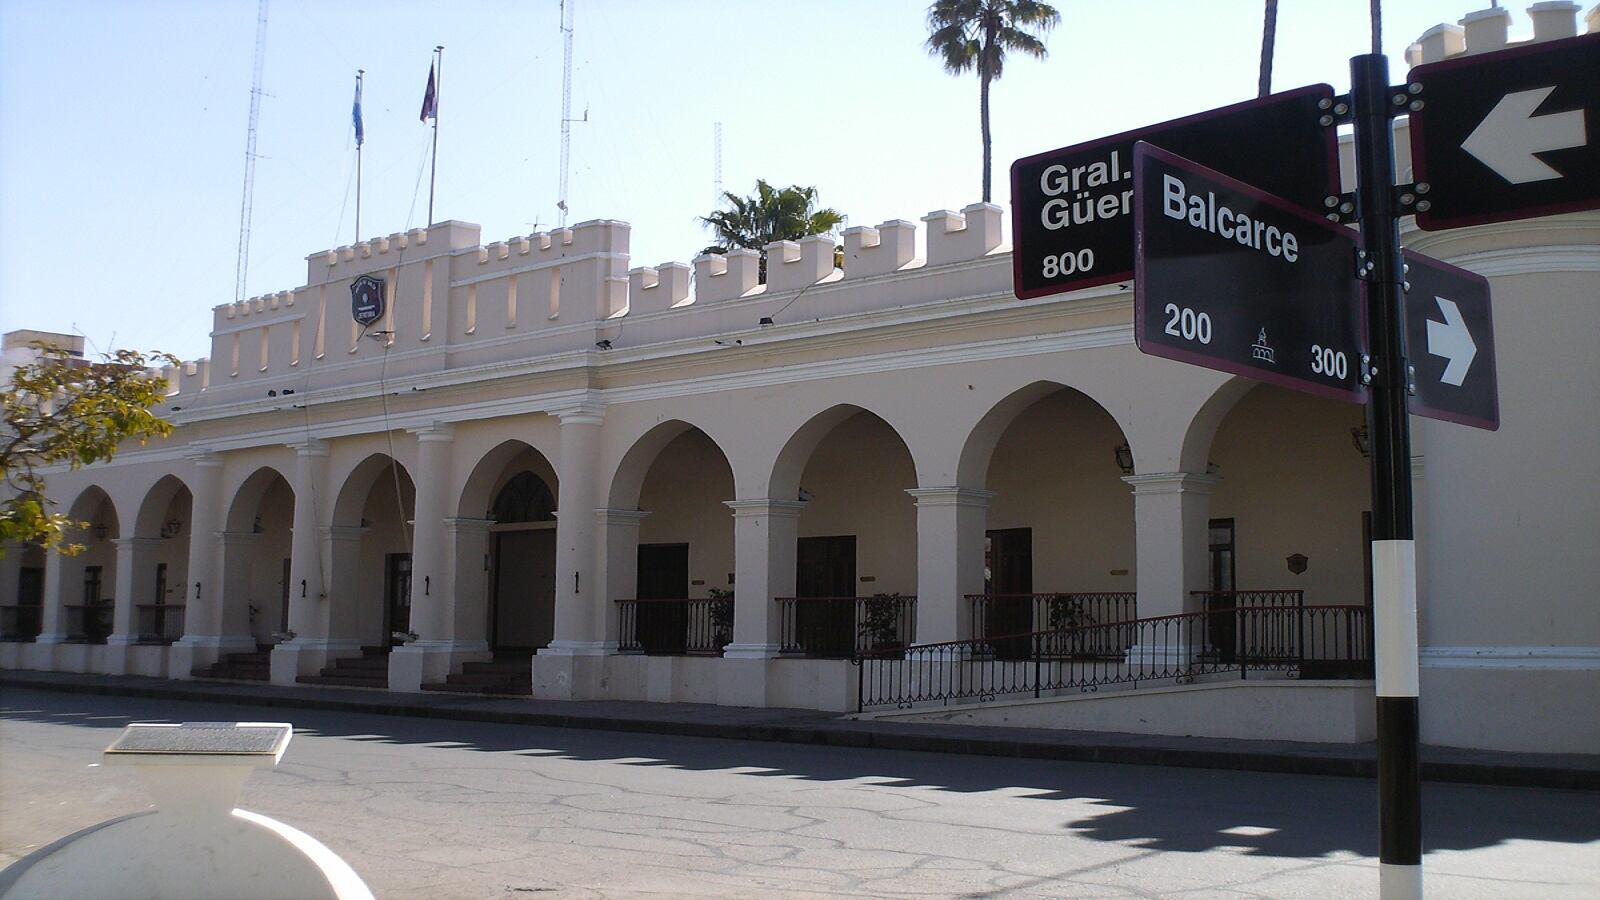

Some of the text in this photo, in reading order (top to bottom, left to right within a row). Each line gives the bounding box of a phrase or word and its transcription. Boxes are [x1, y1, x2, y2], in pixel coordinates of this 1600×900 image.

[1040, 150, 1132, 196] Gral.
[1163, 173, 1299, 263] Balcarce
[1042, 248, 1095, 279] 800
[1164, 302, 1213, 345] 200
[1311, 344, 1348, 380] 300
